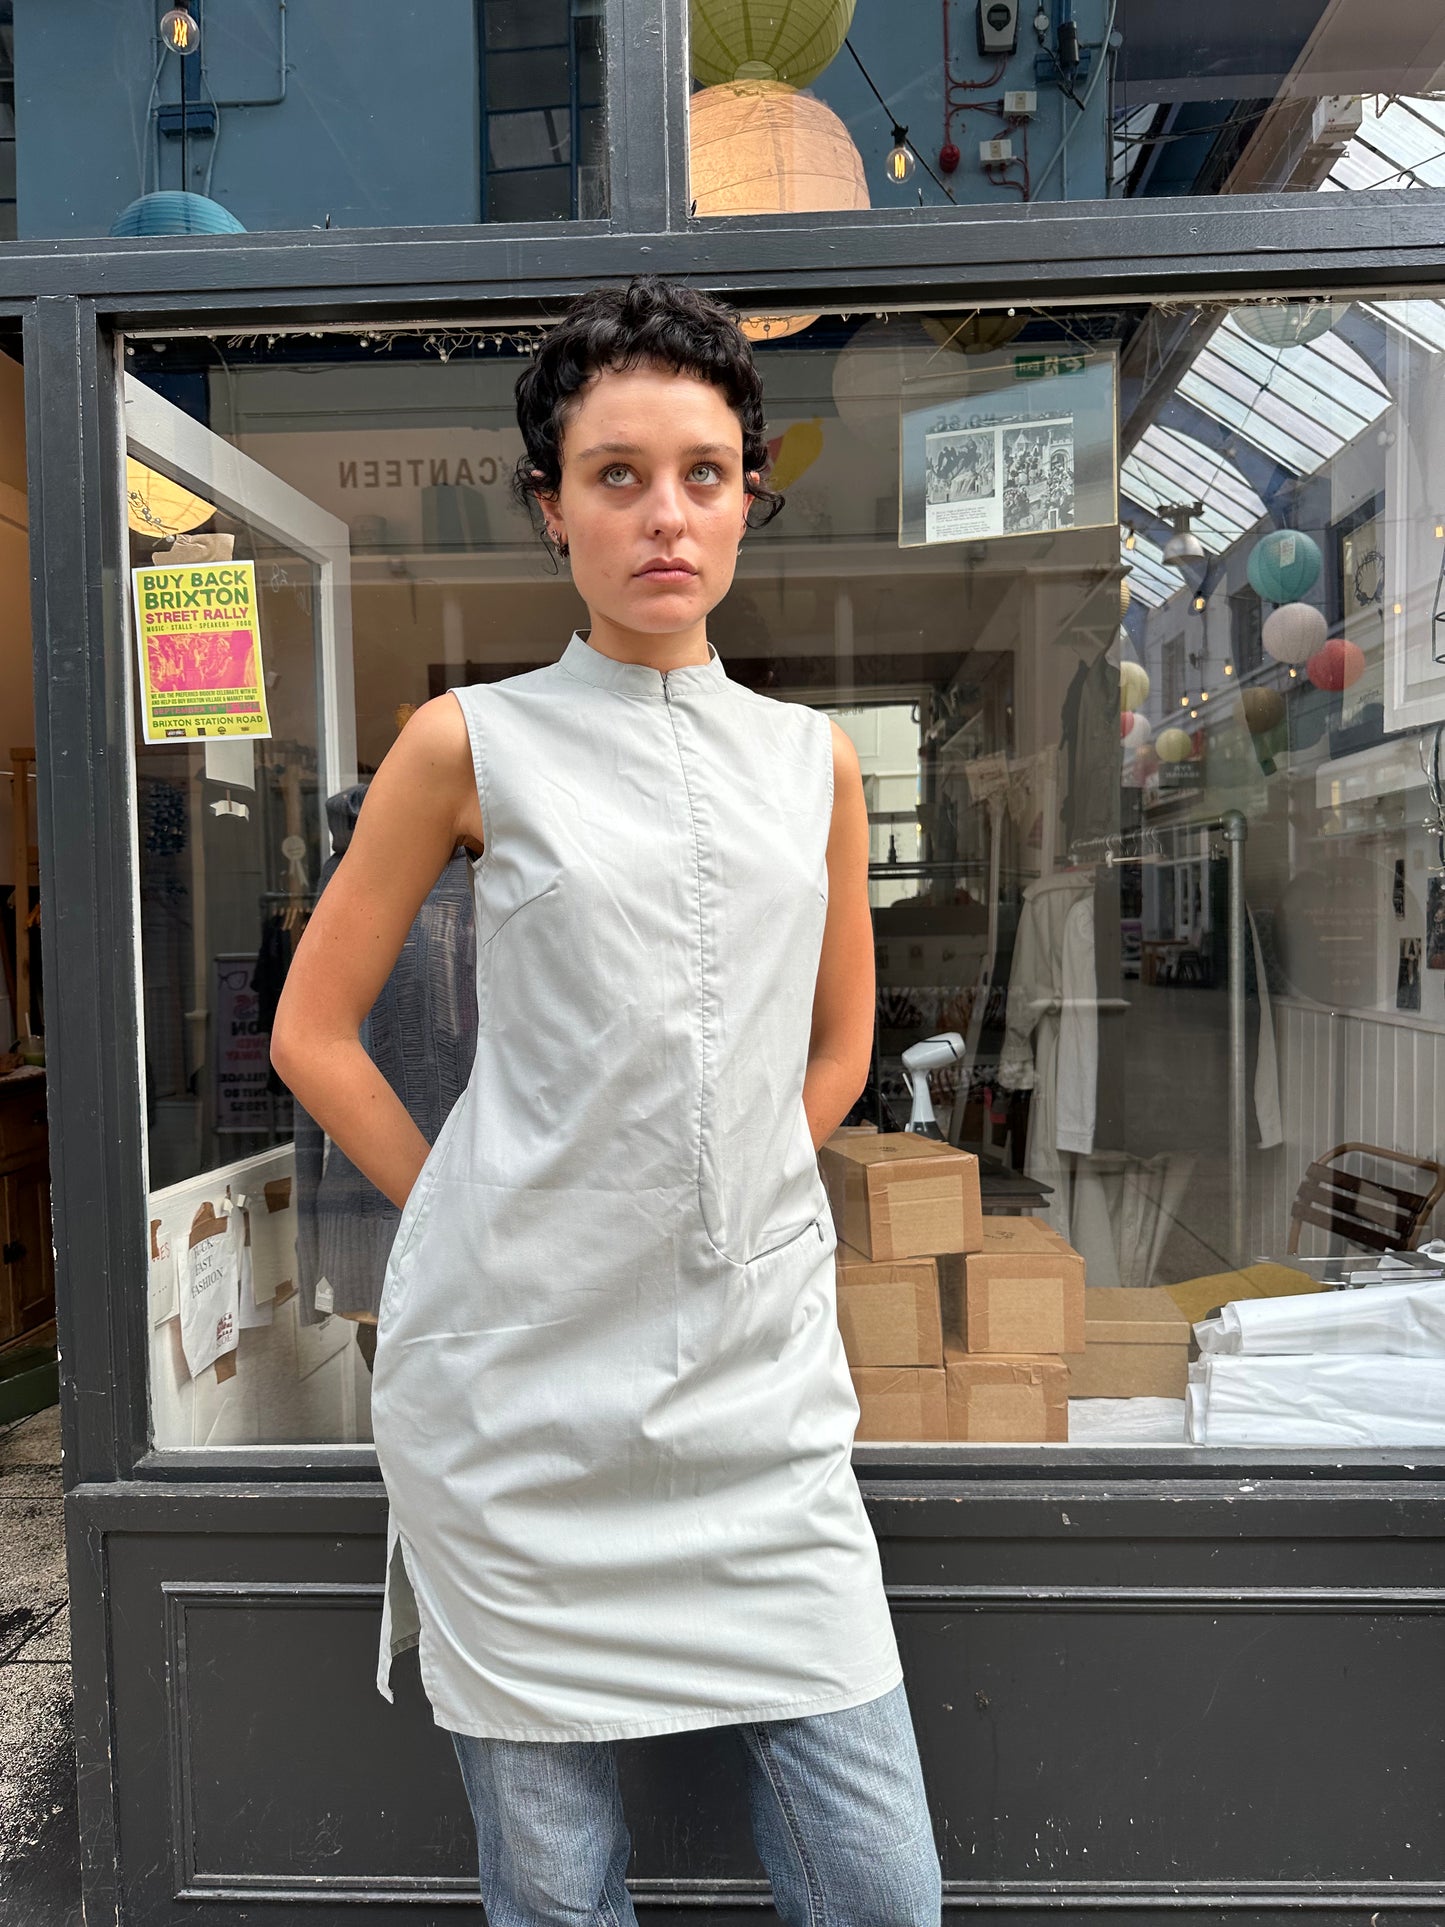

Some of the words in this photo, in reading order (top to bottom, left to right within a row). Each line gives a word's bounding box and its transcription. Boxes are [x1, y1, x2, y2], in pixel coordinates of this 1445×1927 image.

[143, 574, 184, 591] BUY
[191, 570, 247, 588] BACK
[145, 587, 249, 610] BRIXTON
[145, 609, 199, 625] STREET
[203, 607, 249, 621] RALLY
[146, 625, 165, 633] MUSIC
[171, 623, 193, 631] STALLS
[199, 621, 230, 629] SPEAKERS
[153, 705, 205, 715] SEPTEMBER
[152, 719, 192, 728] BRIXTON
[195, 717, 234, 726] STATION
[236, 715, 263, 724] ROAD
[194, 1254, 213, 1277] FAST
[191, 1267, 223, 1299] FASHION
